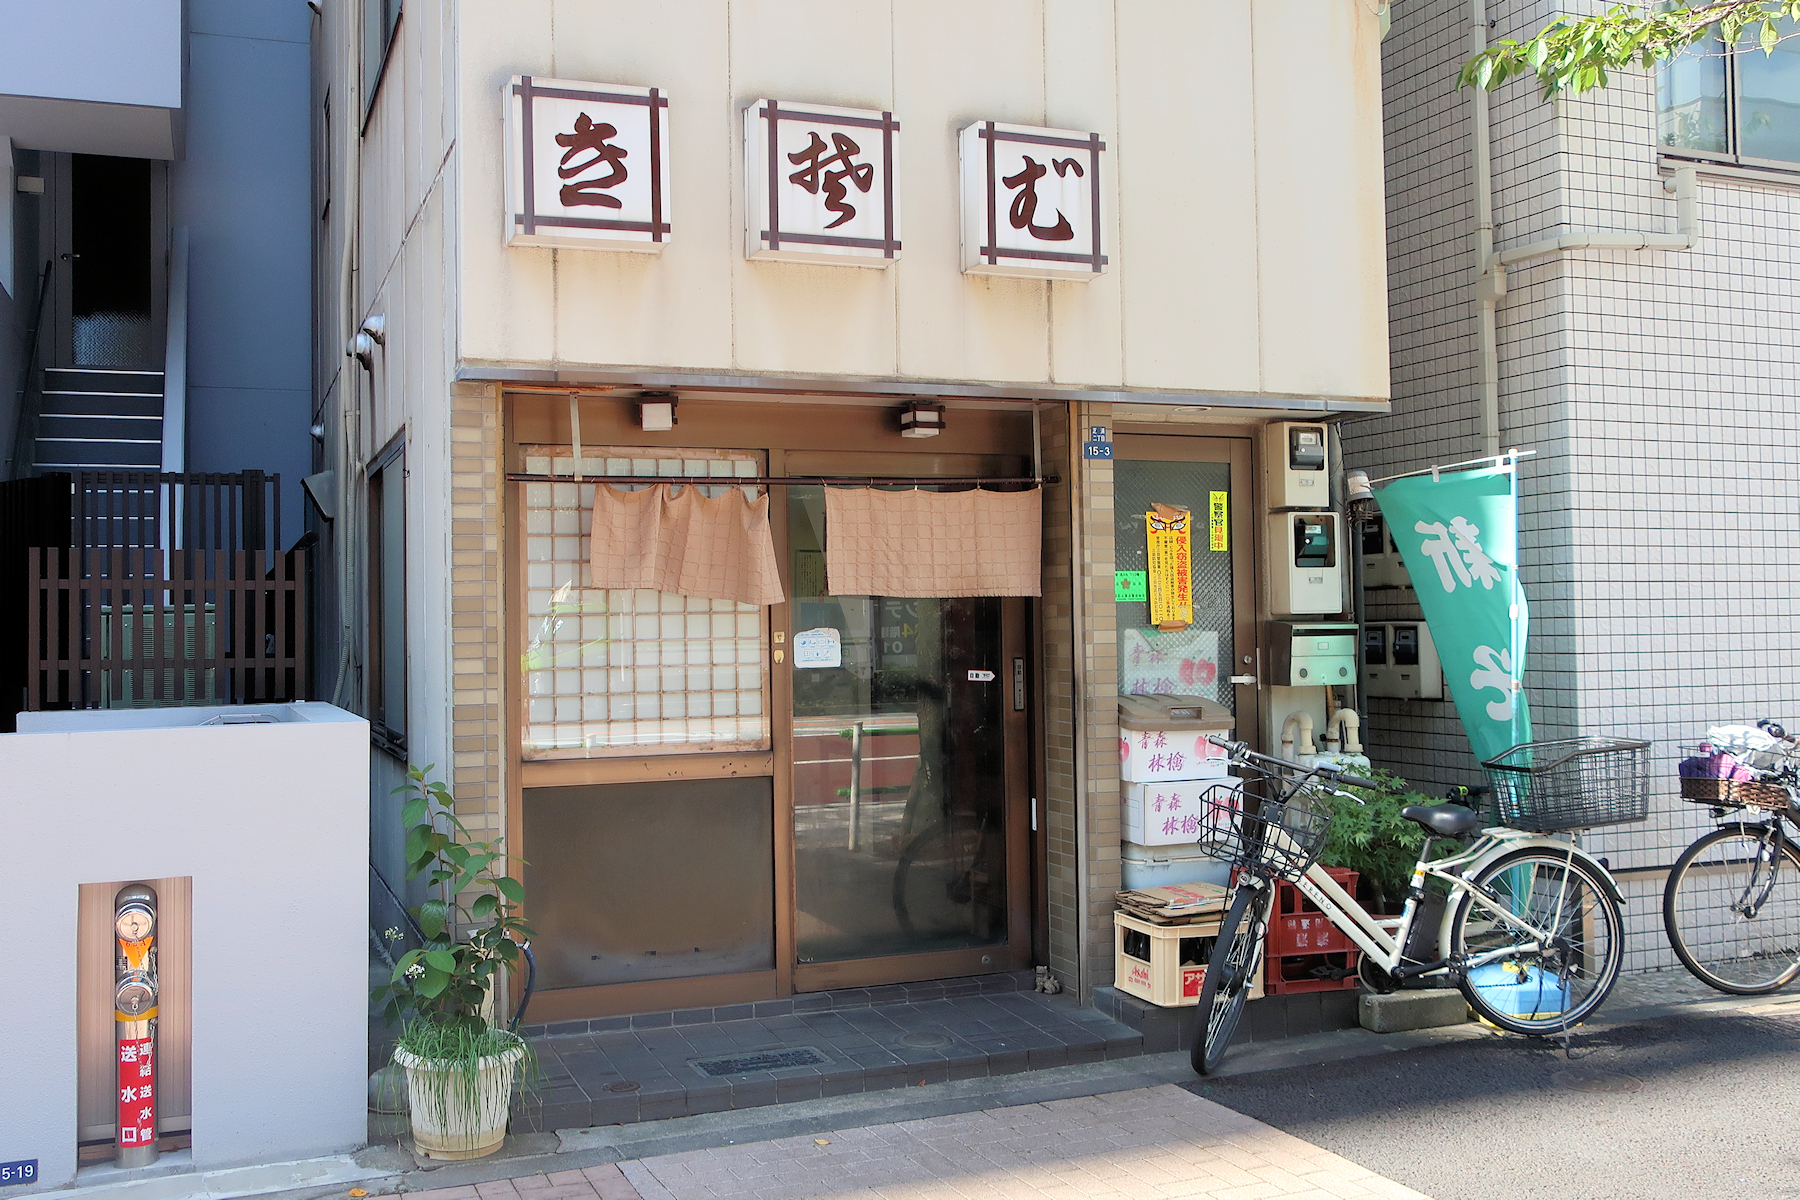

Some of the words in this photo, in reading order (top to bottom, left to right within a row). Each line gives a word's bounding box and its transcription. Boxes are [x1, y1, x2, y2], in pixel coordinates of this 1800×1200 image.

[1088, 446, 1110, 456] 15-3
[1138, 731, 1168, 749] 青森
[1149, 752, 1187, 772] 林檎
[1151, 793, 1182, 812] 青森
[1162, 814, 1199, 835] 林檎
[120, 1045, 138, 1143] 送水口
[2, 1164, 34, 1181] 5-19
